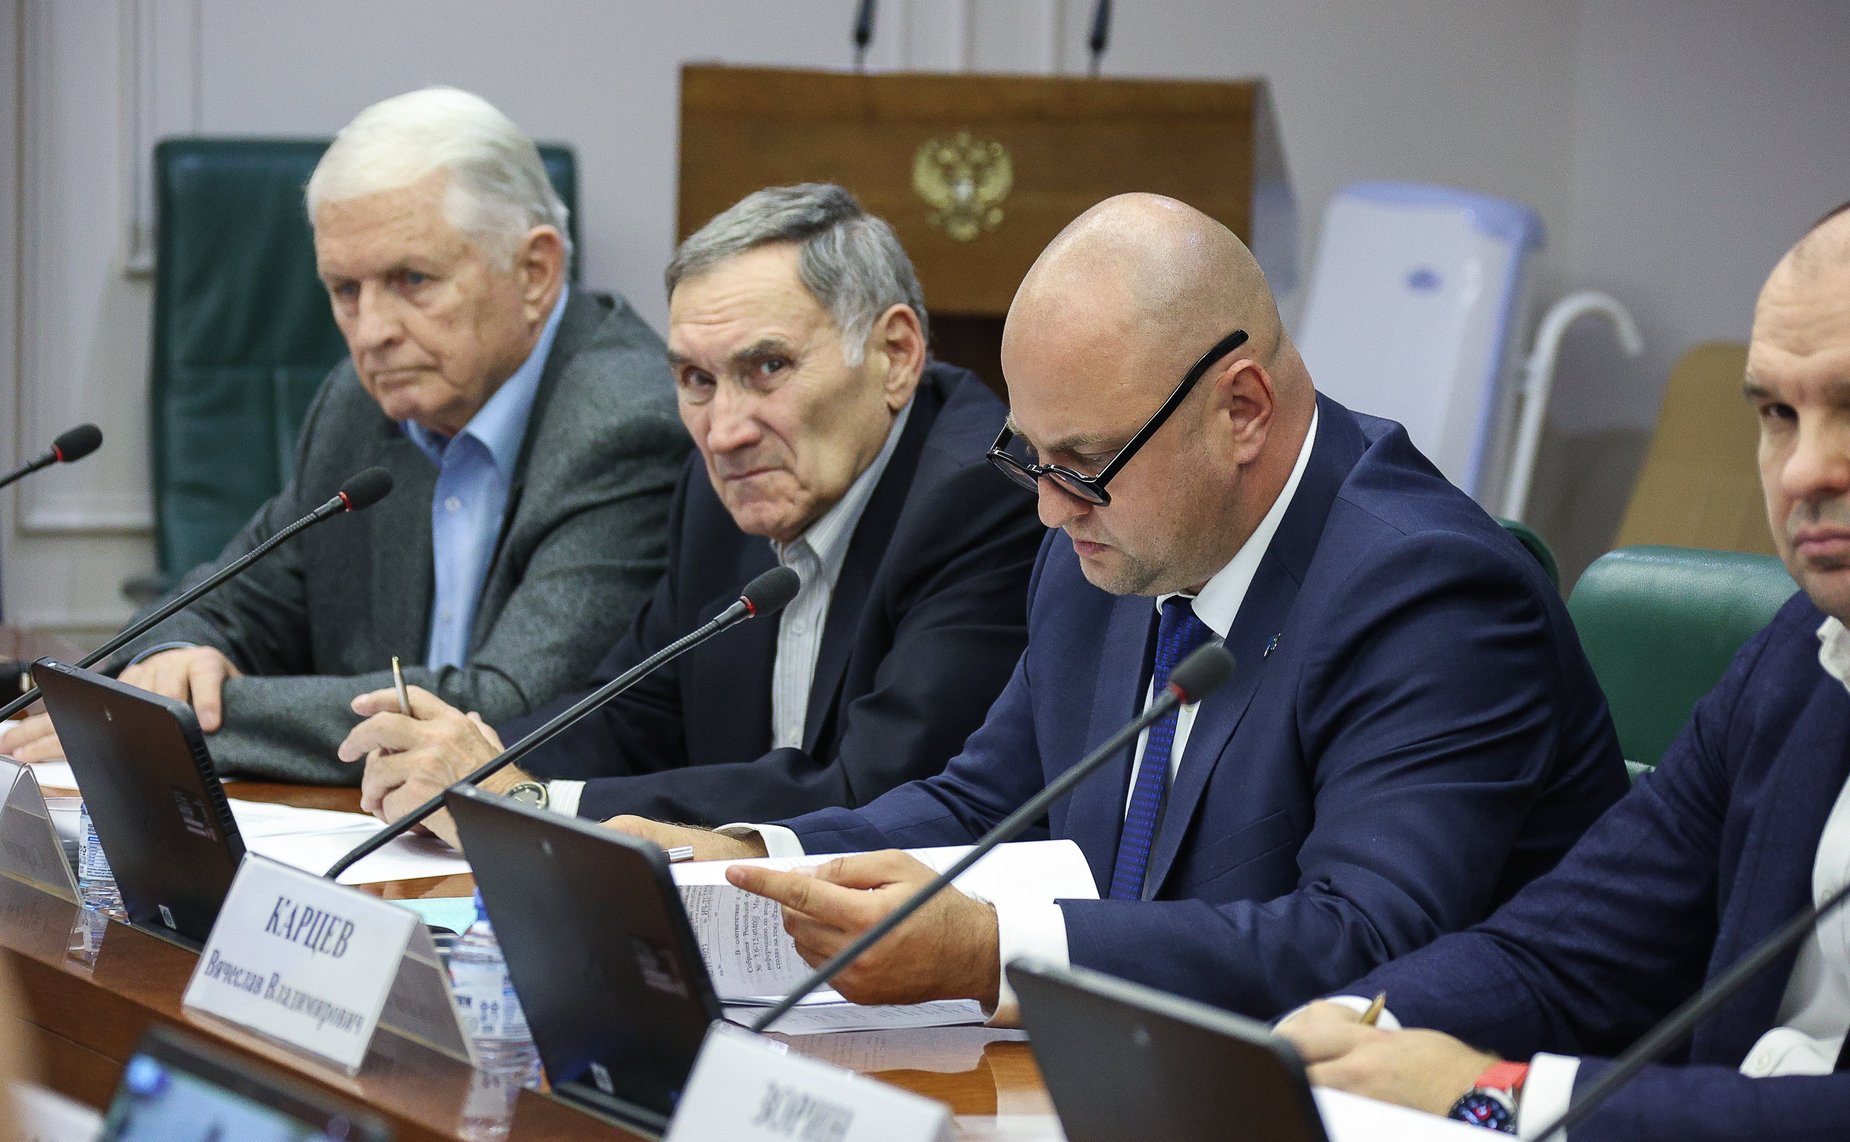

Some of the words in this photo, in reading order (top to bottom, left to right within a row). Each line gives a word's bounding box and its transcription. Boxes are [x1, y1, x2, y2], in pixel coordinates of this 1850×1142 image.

[264, 895, 355, 958] КАРЦЕВ
[744, 941, 754, 974] Собрания
[204, 949, 264, 996] Вячеслав
[263, 972, 365, 1036] Владимирович
